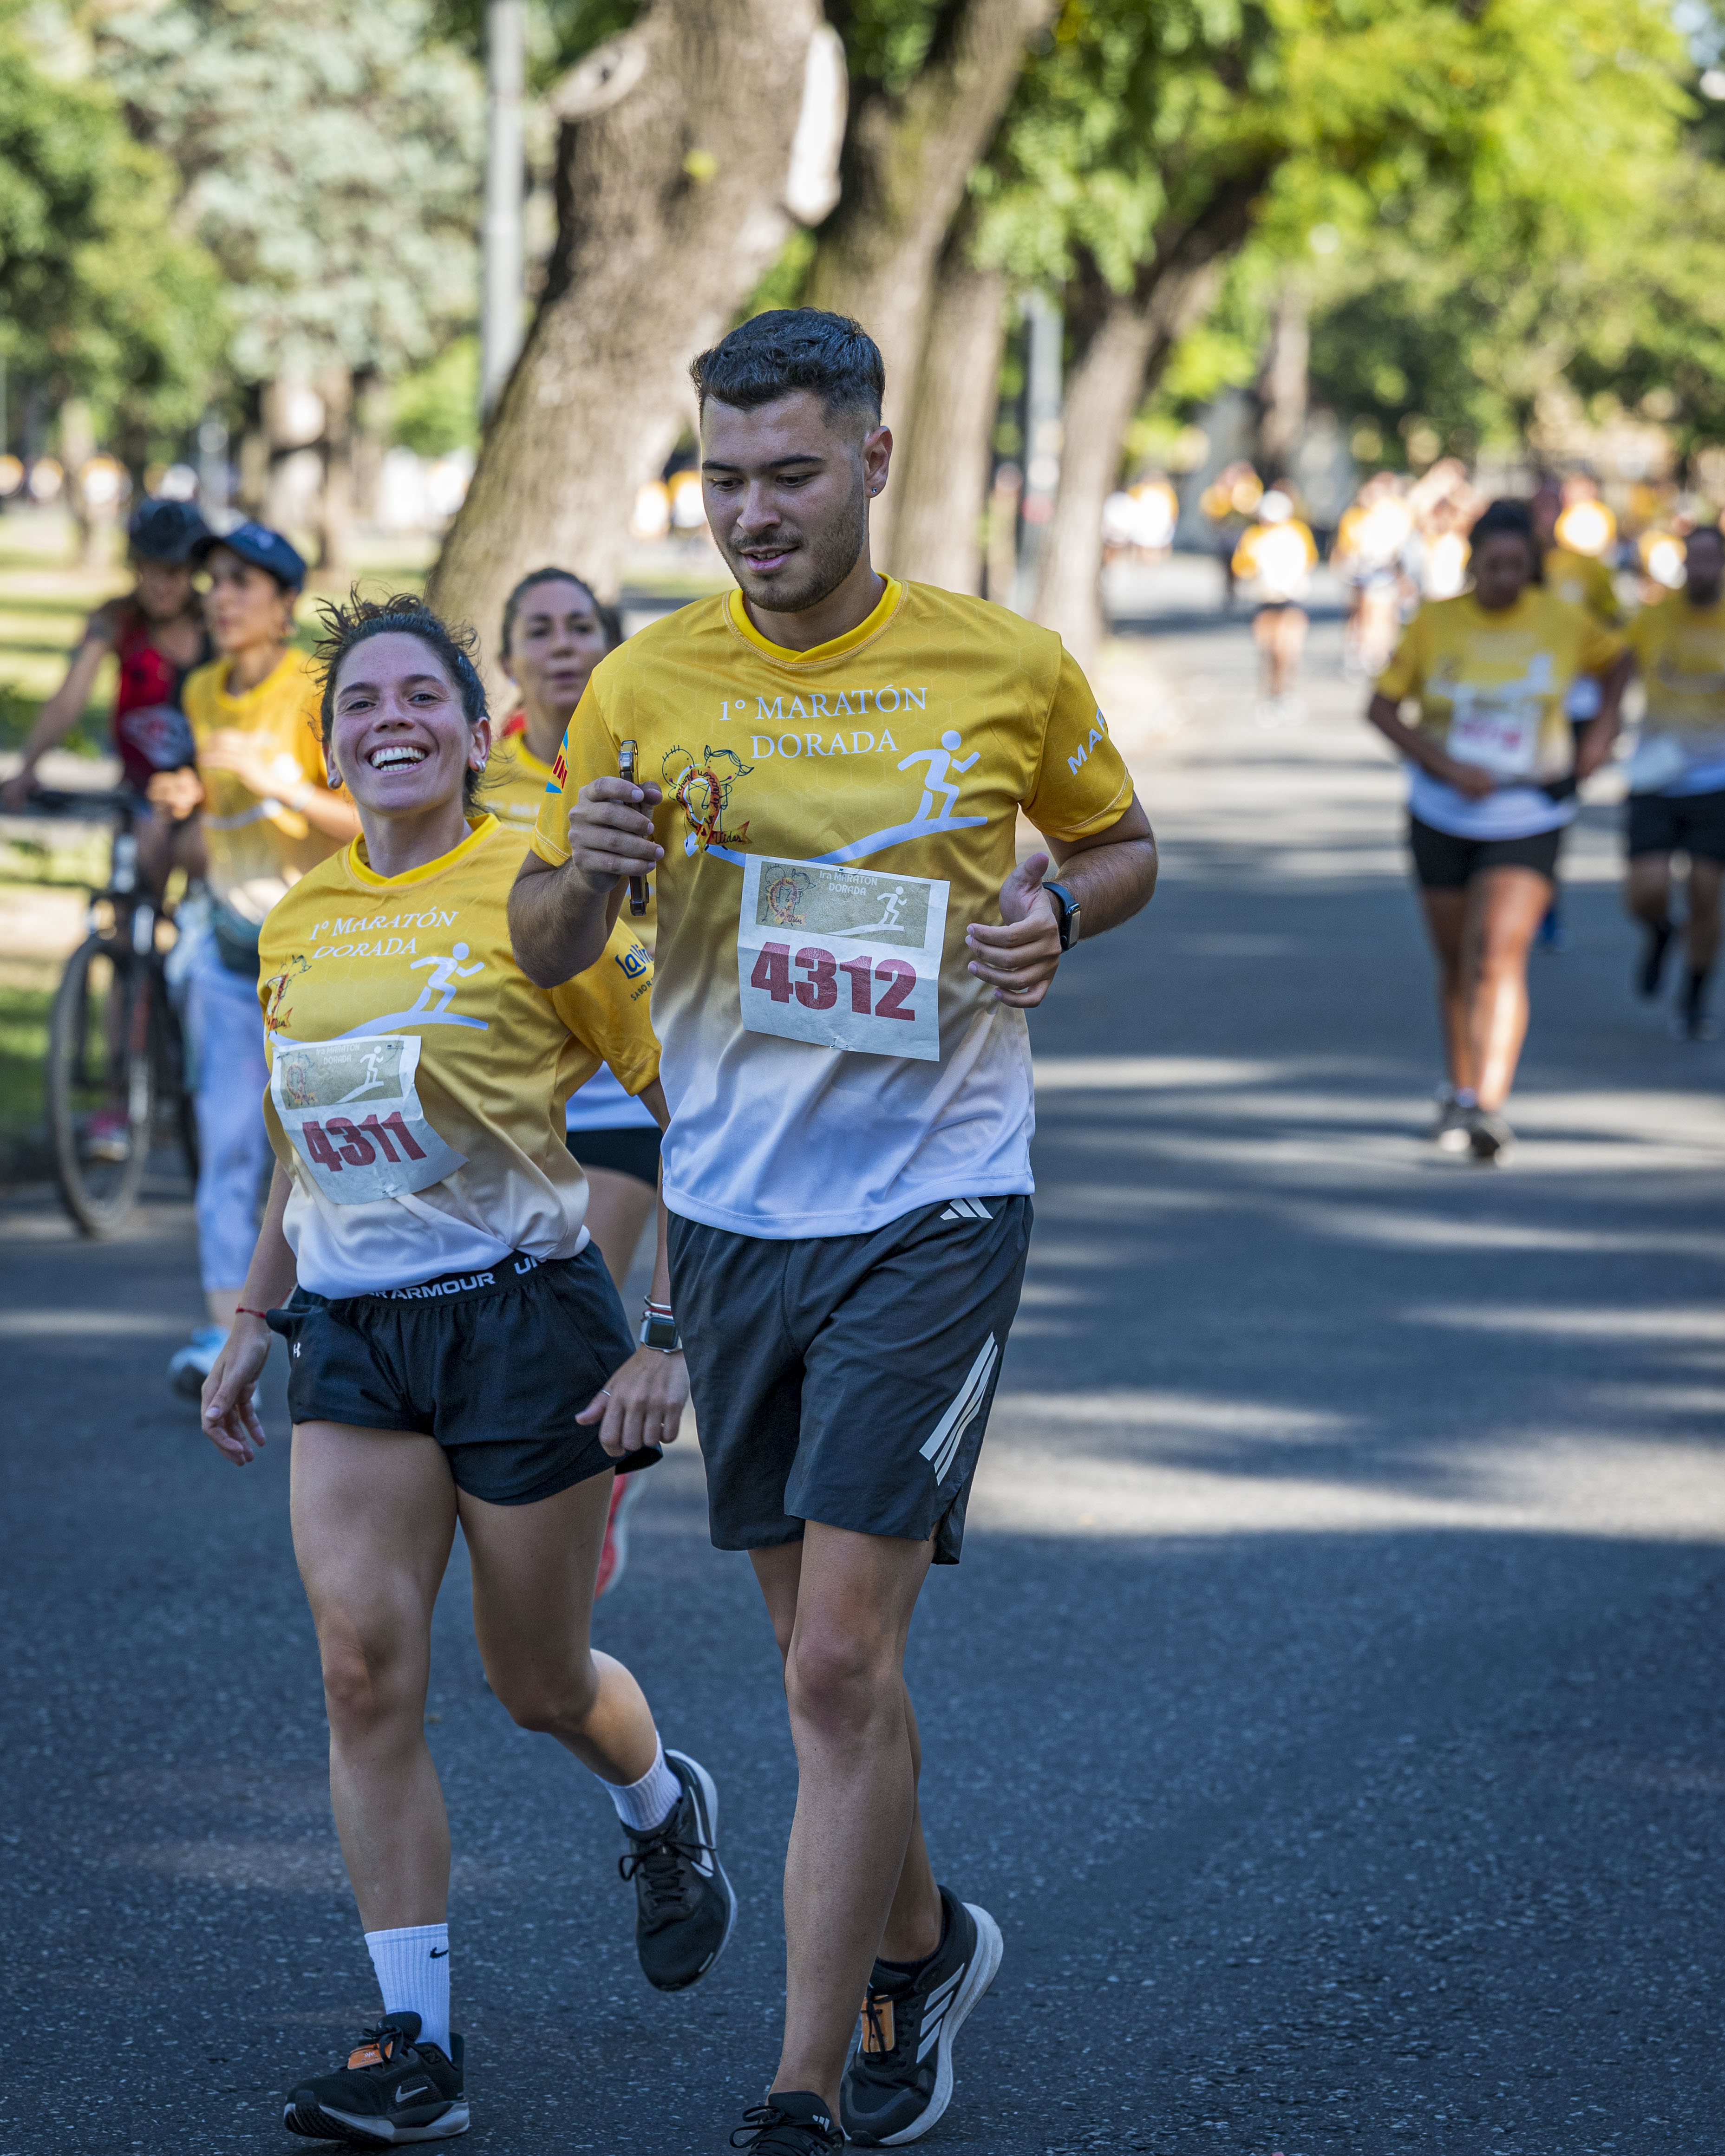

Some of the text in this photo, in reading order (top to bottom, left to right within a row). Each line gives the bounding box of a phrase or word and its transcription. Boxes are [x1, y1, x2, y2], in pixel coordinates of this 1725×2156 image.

[755, 684, 928, 719] MARATÓN
[751, 729, 900, 758] DORADA
[828, 883, 867, 896] DORADA
[834, 873, 878, 886] MARATON
[331, 906, 459, 937] MARATÓN
[312, 937, 417, 959] DORADA
[631, 978, 653, 1001] SABOR
[751, 941, 917, 1021] 4312
[323, 1054, 352, 1065] DORADA
[327, 1043, 360, 1054] MARATON
[302, 1111, 427, 1172] 4311
[391, 1272, 496, 1299] ARMOUR
